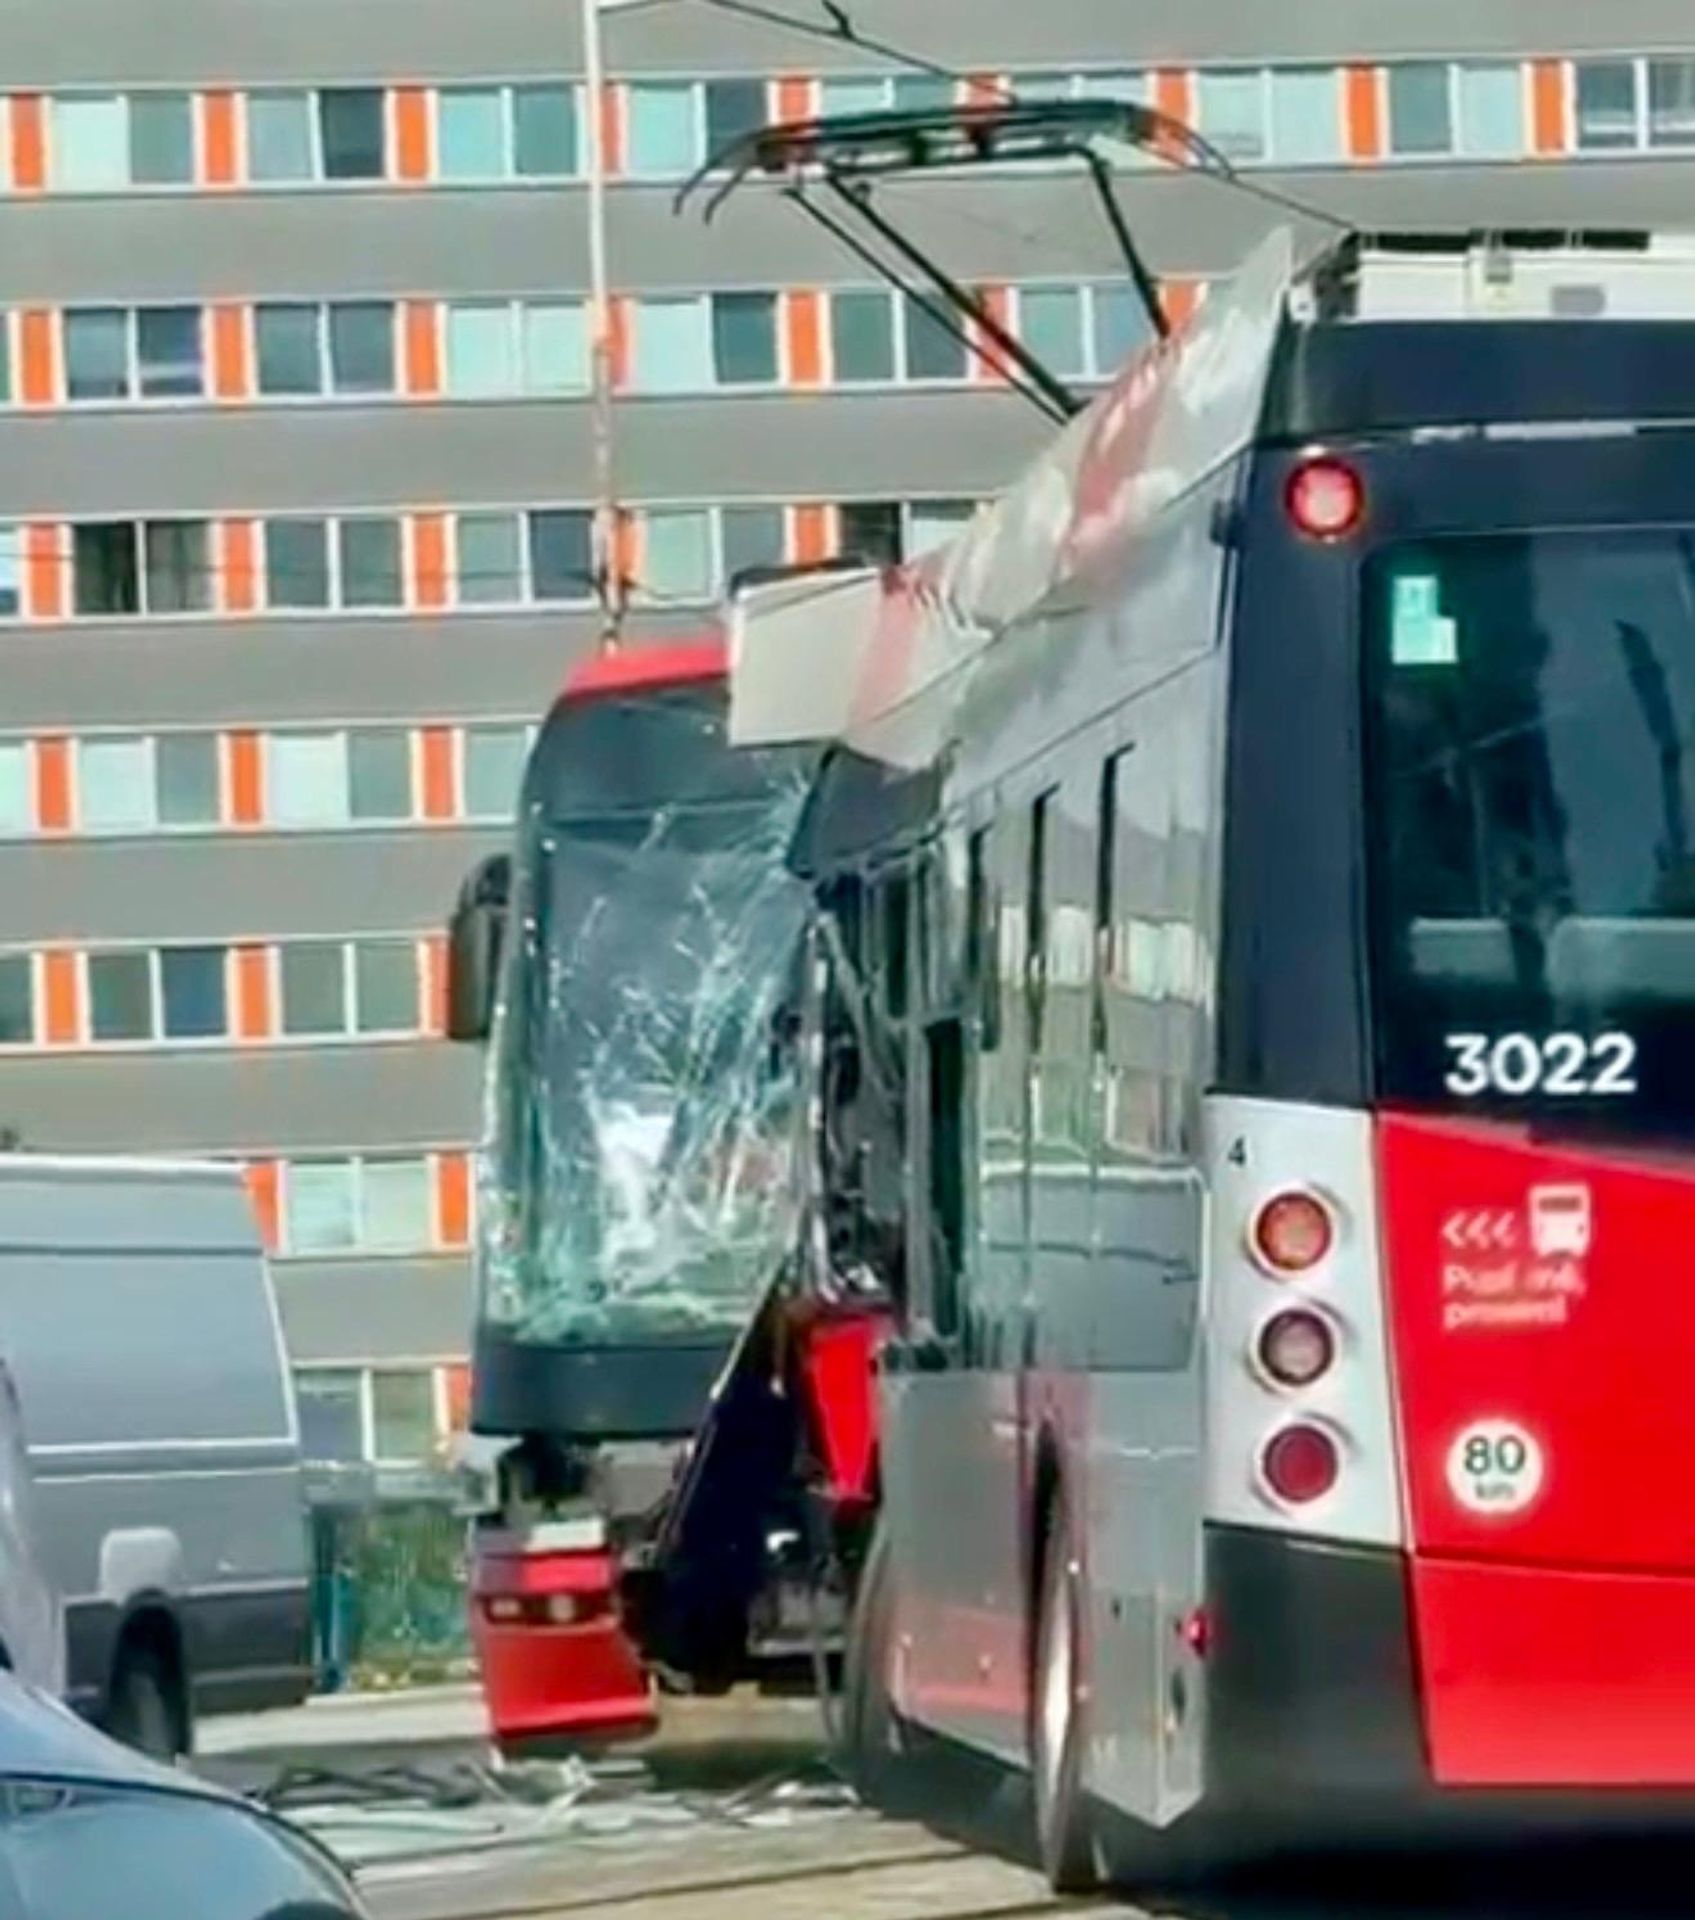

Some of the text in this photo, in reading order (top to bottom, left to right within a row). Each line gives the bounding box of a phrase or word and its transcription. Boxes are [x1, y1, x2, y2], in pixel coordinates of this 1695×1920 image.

[1444, 1032, 1637, 1094] 3022
[1227, 1135, 1246, 1168] 4
[1464, 1435, 1526, 1475] 80
